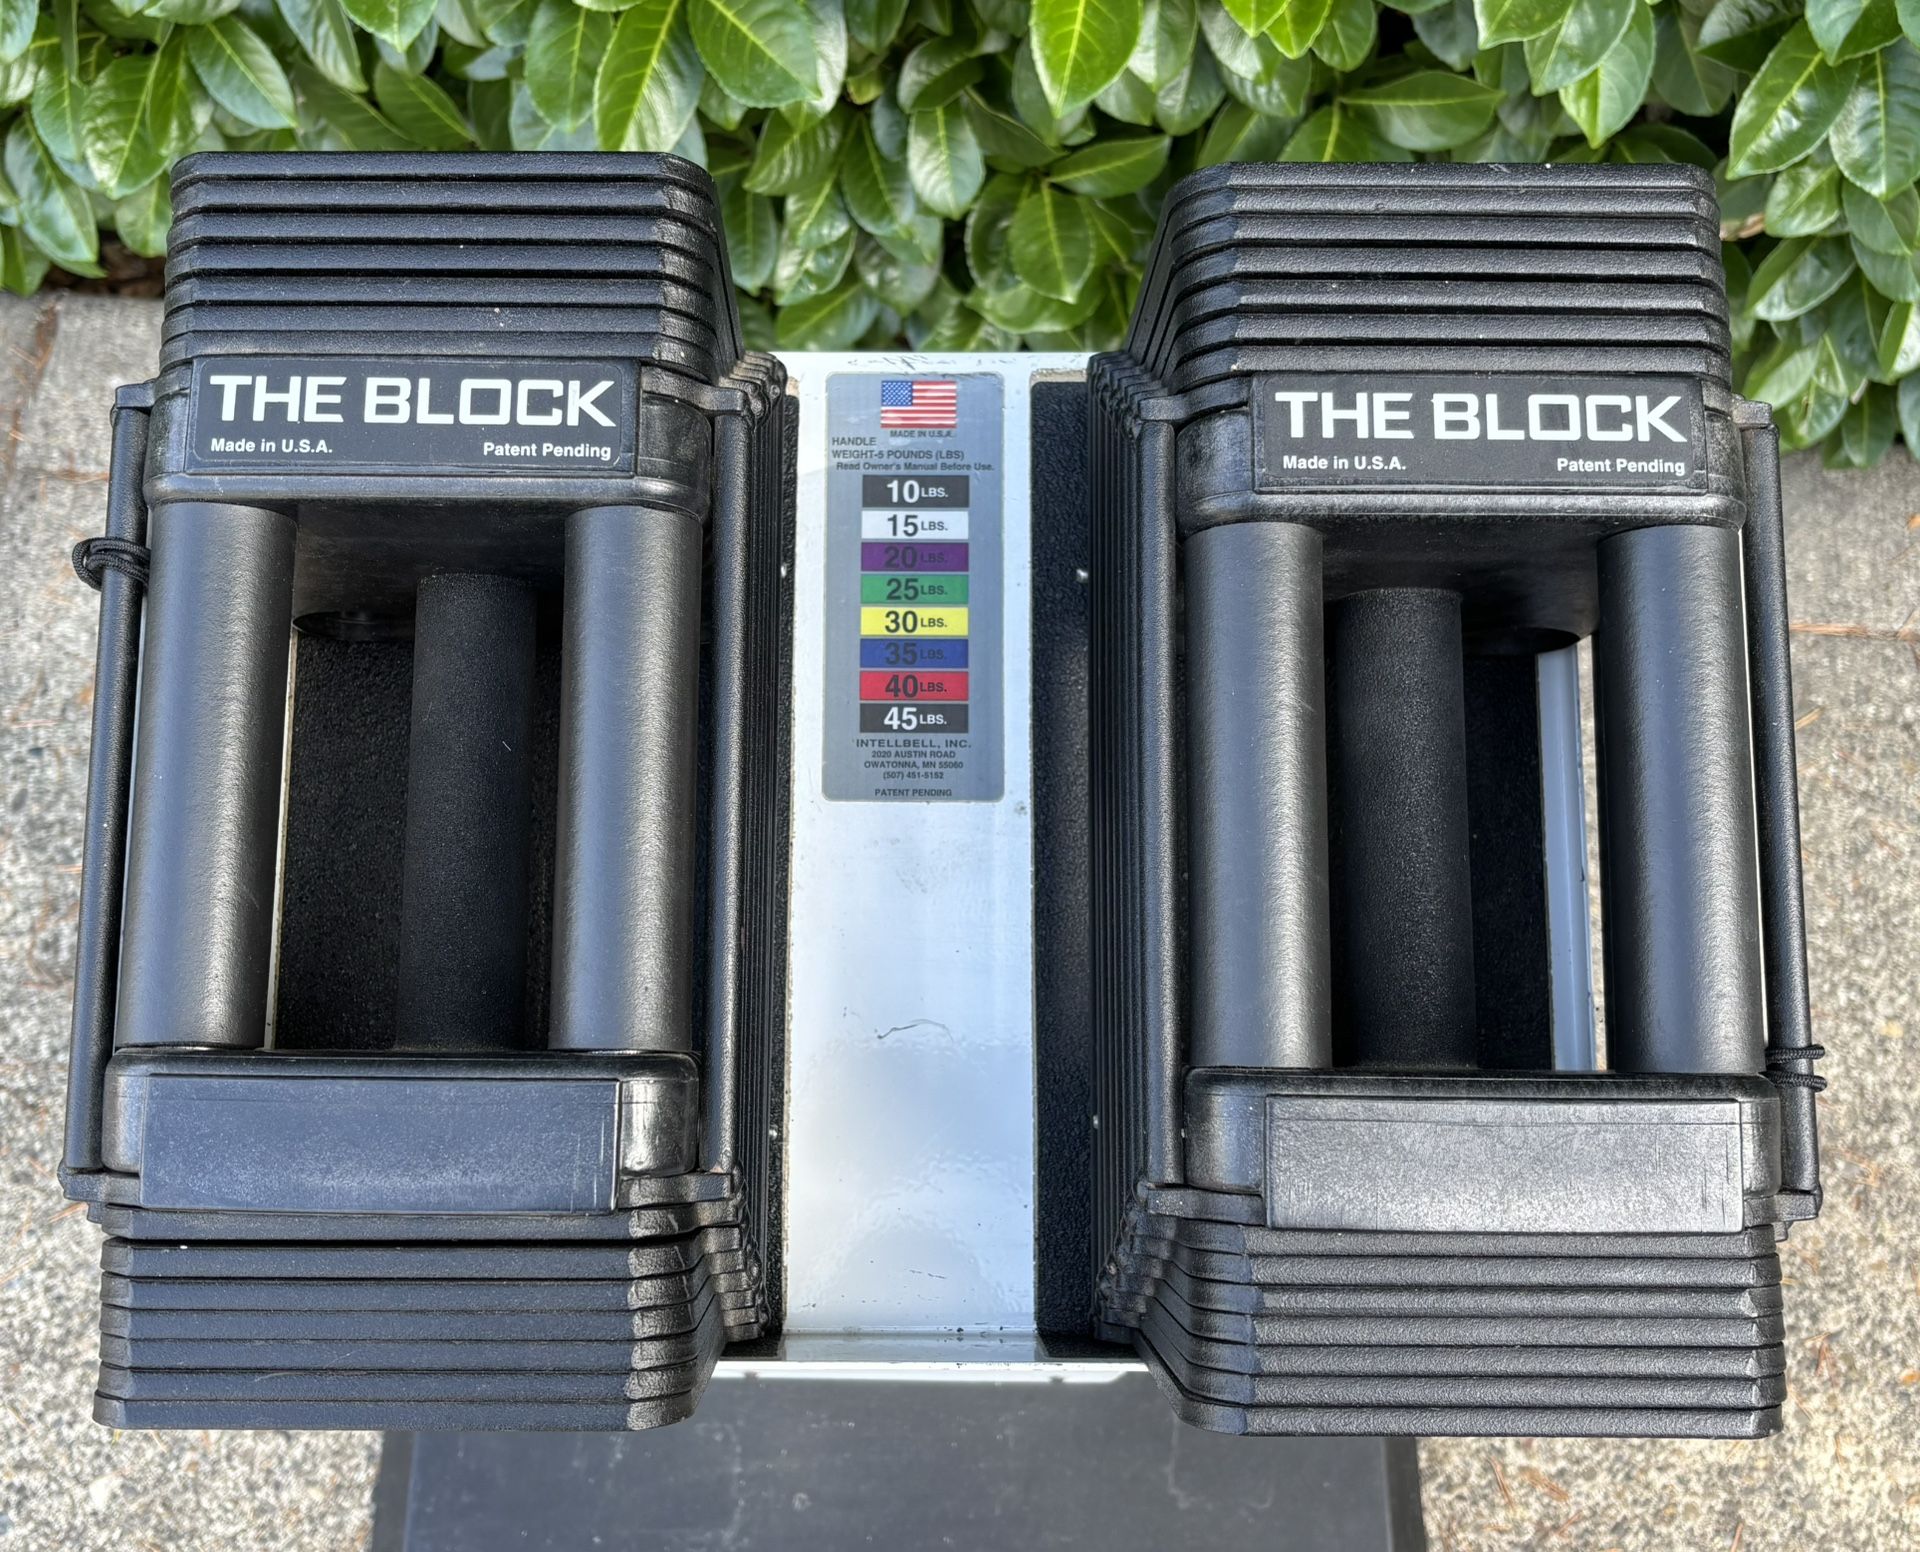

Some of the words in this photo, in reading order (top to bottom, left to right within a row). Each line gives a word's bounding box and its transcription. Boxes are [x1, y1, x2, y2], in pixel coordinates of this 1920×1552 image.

[210, 375, 347, 422] THE
[364, 377, 616, 426] BLOCK
[1275, 392, 1414, 439] THE
[1431, 393, 1687, 442] BLOCK
[211, 439, 256, 452] Made
[260, 440, 276, 452] in
[282, 440, 333, 453] U.S.A.
[832, 437, 876, 446] HANDLE
[483, 443, 537, 457] Patent
[542, 443, 611, 460] Pending
[832, 450, 884, 459] WEIGHT-5
[887, 450, 933, 459] POUNDS
[935, 451, 964, 461] (LBS)
[974, 463, 994, 471] Use.
[1283, 456, 1329, 469] Made
[1333, 456, 1350, 470] in
[1355, 456, 1406, 470] U.S.A.
[1557, 458, 1611, 472] Patent
[1616, 459, 1685, 476] Pending
[887, 480, 920, 503] 10
[921, 487, 948, 497] LBS.
[887, 515, 919, 537] 15
[921, 521, 948, 531] LBS.
[884, 546, 919, 568] 20
[886, 579, 918, 600] 25
[921, 585, 948, 595] LBS.
[885, 611, 917, 633] 30
[920, 618, 947, 627] LBS.
[885, 642, 917, 665] 35
[885, 675, 918, 697] 40
[884, 707, 917, 730] 45
[920, 715, 947, 724] LBS.
[856, 739, 941, 749] INTELLBELL,
[945, 739, 971, 748] INC.
[864, 761, 920, 769] OWATONNA,
[922, 761, 937, 769] MN
[883, 771, 904, 780] (507)
[912, 789, 952, 797] PENDING
